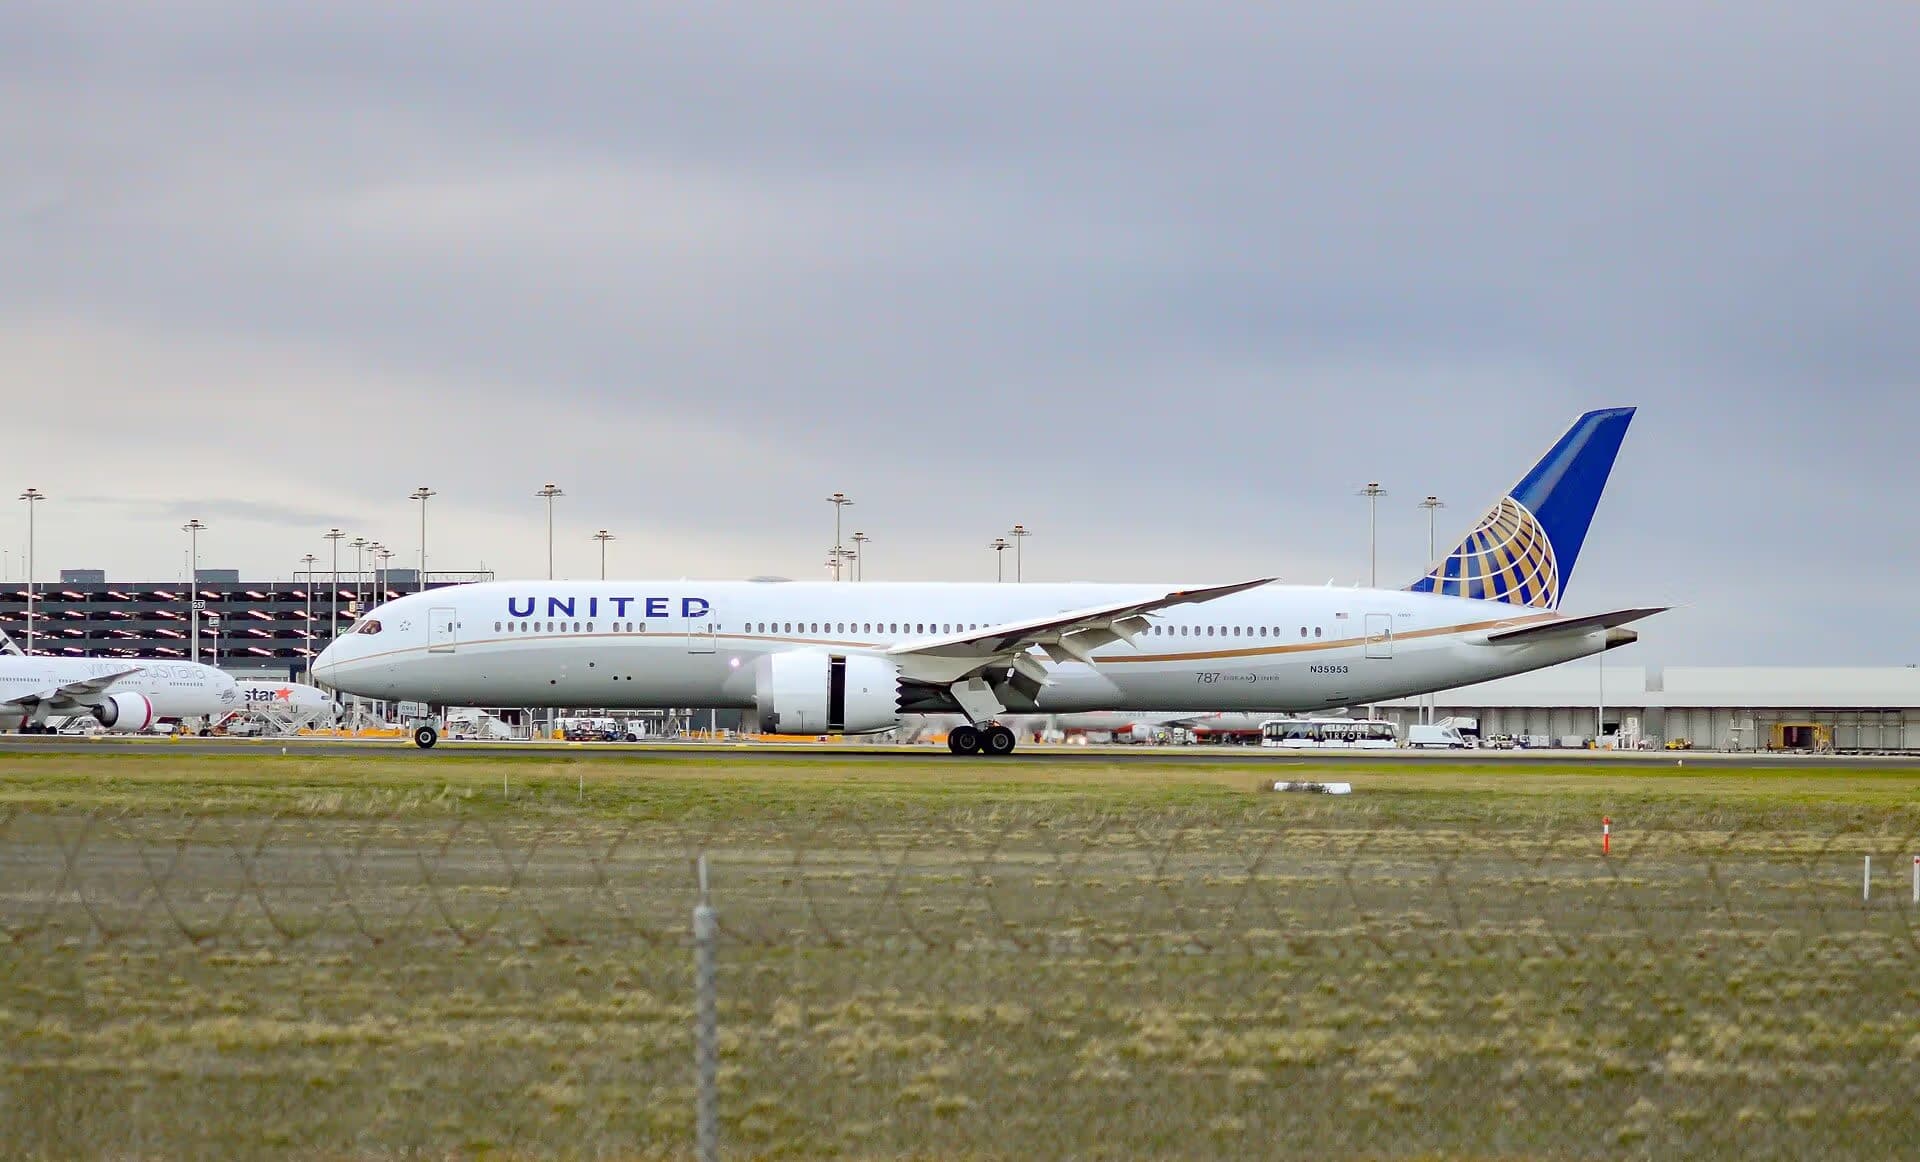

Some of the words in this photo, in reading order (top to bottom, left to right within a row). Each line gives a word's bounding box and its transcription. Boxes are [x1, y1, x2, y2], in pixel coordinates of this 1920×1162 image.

[508, 597, 710, 618] UNITED
[138, 664, 206, 679] australia
[1310, 665, 1349, 674] N35953
[1196, 672, 1221, 684] 787
[1322, 732, 1369, 740] AIRPORT
